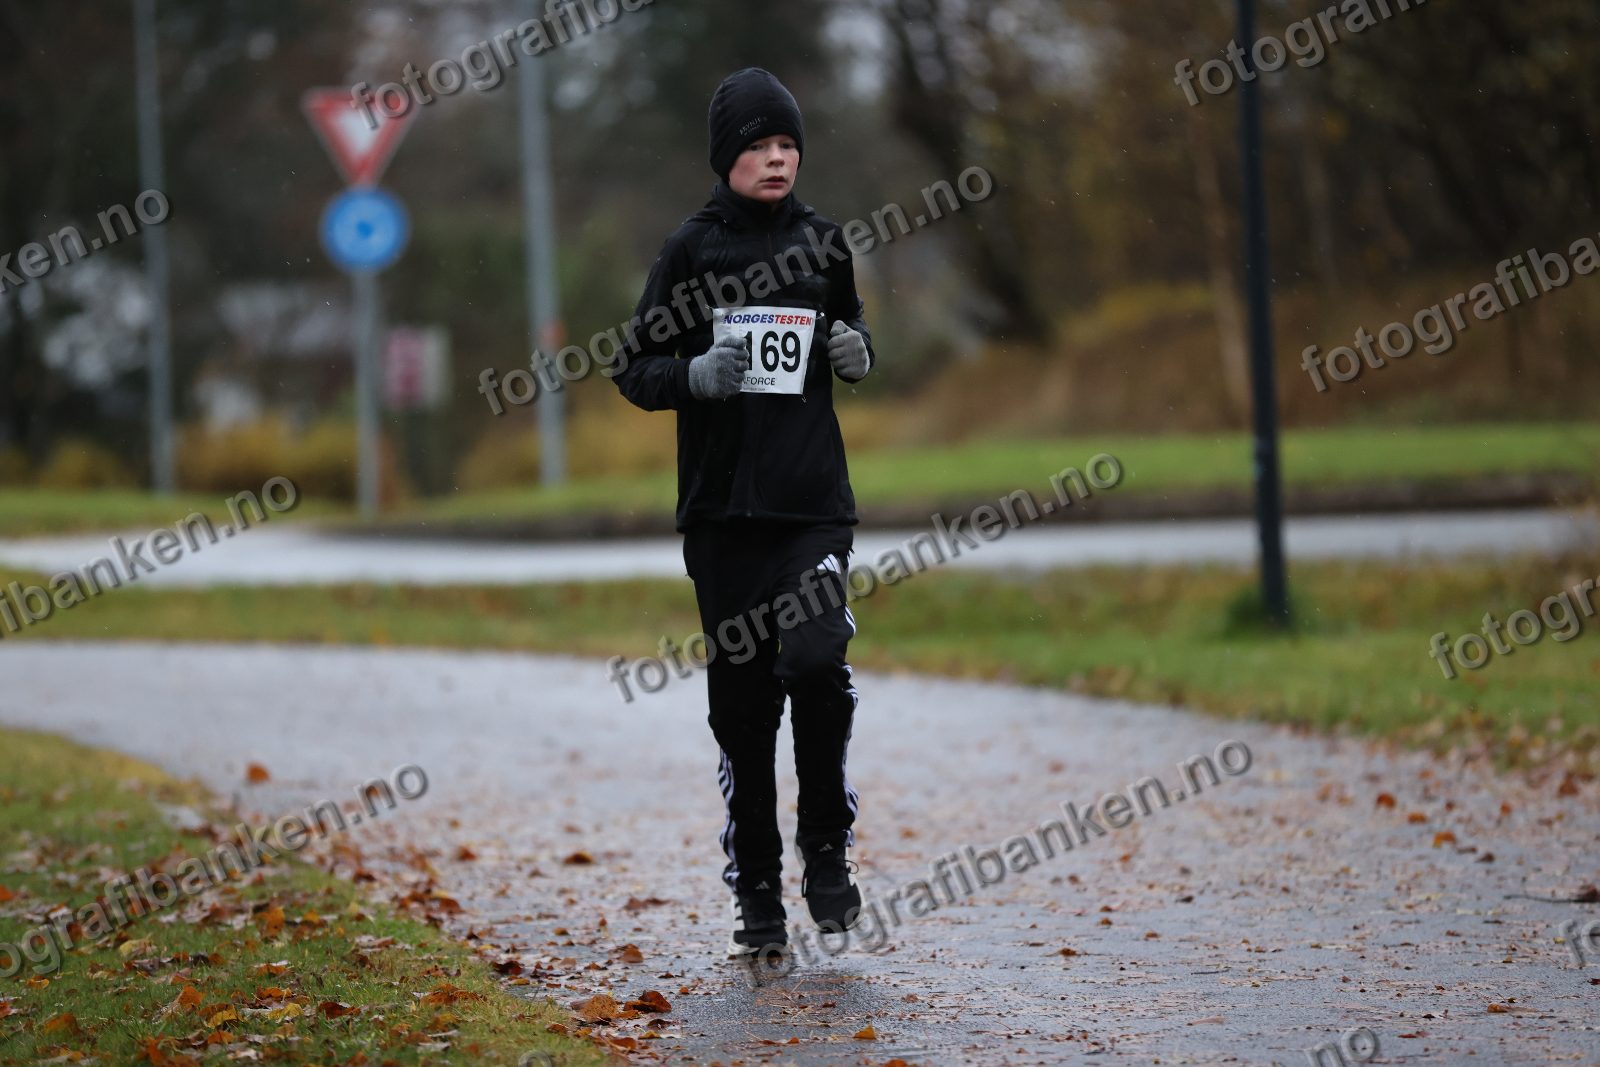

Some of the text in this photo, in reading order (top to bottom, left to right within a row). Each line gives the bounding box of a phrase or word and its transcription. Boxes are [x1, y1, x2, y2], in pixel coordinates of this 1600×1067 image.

[724, 314, 813, 325] NORGESTESTEN
[744, 330, 801, 373] 169
[743, 376, 776, 386] FORCE
